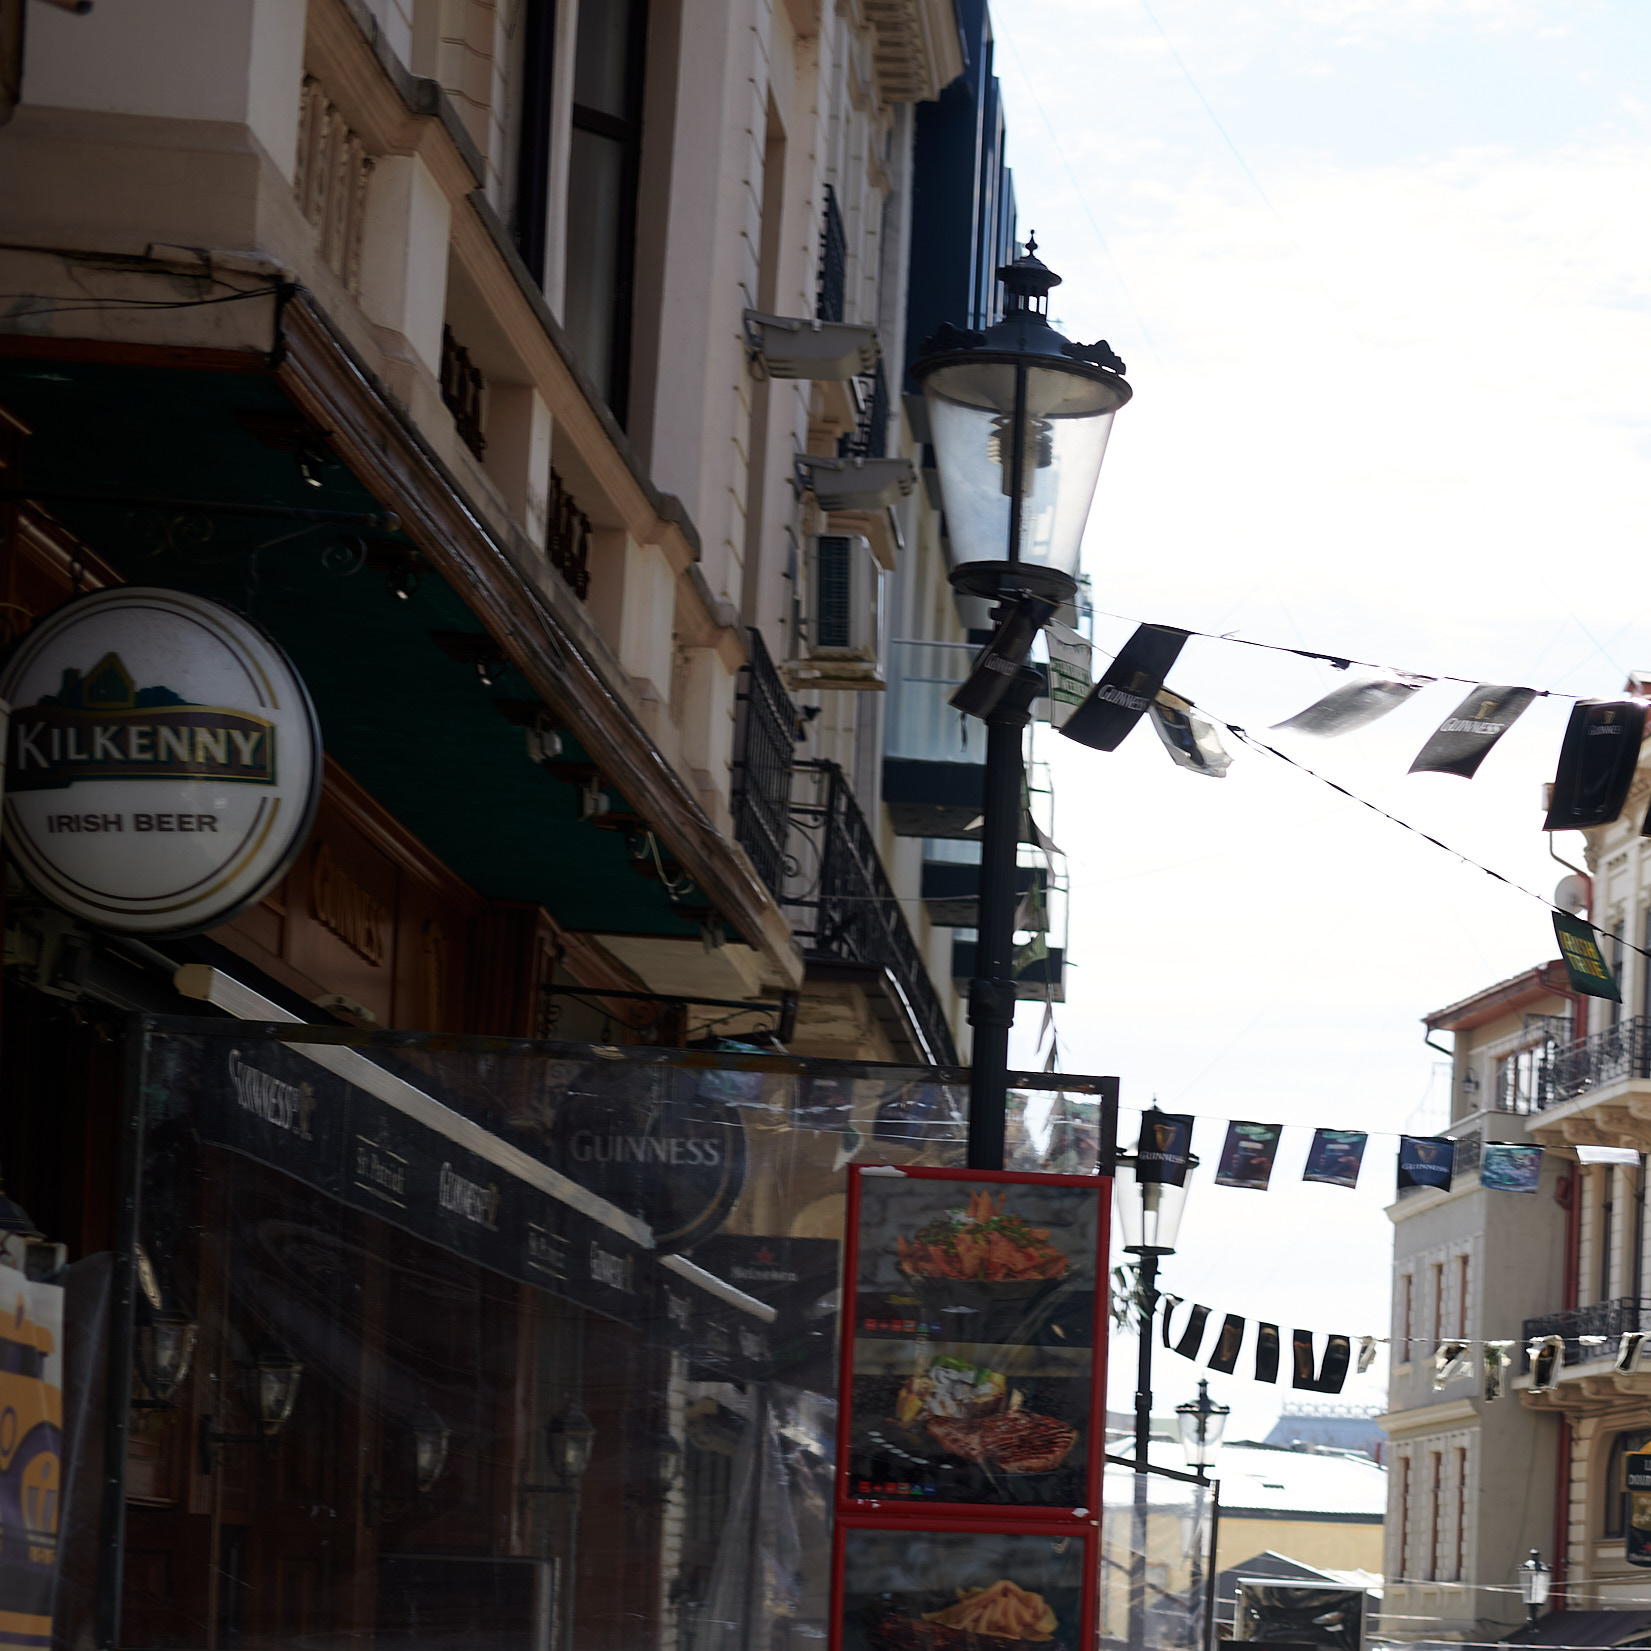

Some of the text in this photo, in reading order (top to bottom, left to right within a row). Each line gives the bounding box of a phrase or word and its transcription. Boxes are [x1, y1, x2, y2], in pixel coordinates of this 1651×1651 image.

[1440, 717, 1504, 736] GUINNESS
[17, 719, 264, 770] KILKENNY
[48, 812, 219, 834] IRISH BEER
[571, 1130, 721, 1167] GUINNESS
